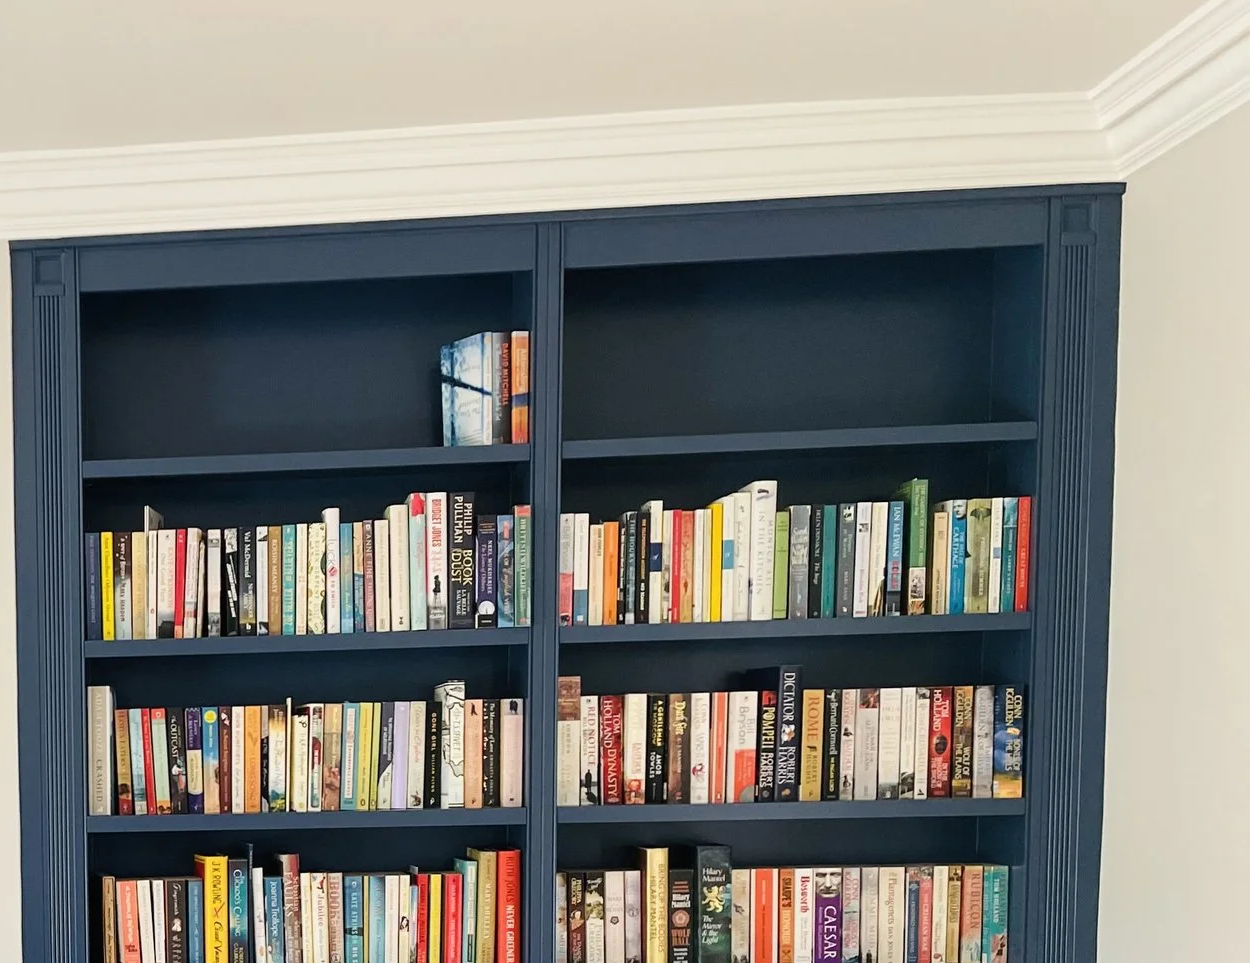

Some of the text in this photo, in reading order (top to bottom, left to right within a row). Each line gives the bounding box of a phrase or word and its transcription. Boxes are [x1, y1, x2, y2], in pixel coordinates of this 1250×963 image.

[432, 499, 441, 547] BRIDGET JONES
[454, 496, 463, 543] PULLMAN
[464, 503, 472, 535] PHILIP
[759, 511, 765, 521] IN
[451, 553, 461, 583] DUST
[463, 550, 473, 585] BOOK
[756, 551, 764, 595] KITCHEN
[462, 589, 466, 597] LA
[603, 700, 613, 748] HOLLAND
[738, 706, 749, 744] Bryson
[807, 697, 820, 742] ROME
[933, 689, 941, 731] HOLLAND
[941, 700, 949, 717] TOM
[956, 689, 964, 727] IGGULDEN
[1005, 688, 1014, 726] IGGULDEN
[1014, 695, 1022, 718] CONN
[587, 706, 596, 766] RED NOTICE
[762, 707, 776, 748] POMPEII
[783, 672, 796, 784] DICTATOR ROBERT
[607, 749, 617, 797] DYNASTY
[759, 753, 768, 787] HARRIS
[778, 747, 787, 784] HARRIS
[955, 757, 963, 779] PLAINS
[212, 875, 222, 904] ROWLING
[658, 864, 666, 889] BRING
[800, 876, 810, 913] Bosworth
[233, 869, 242, 936] CUCKOO'S CALLING
[270, 881, 280, 937] Joanna Trollope
[658, 892, 665, 903] UP
[782, 877, 792, 945] SHARPE'S HONOUR
[885, 877, 897, 925] Plantagenets
[970, 873, 981, 929] RUBICON
[214, 921, 223, 942] Casual
[702, 922, 722, 930] Mirror
[823, 905, 837, 959] CAESAR
